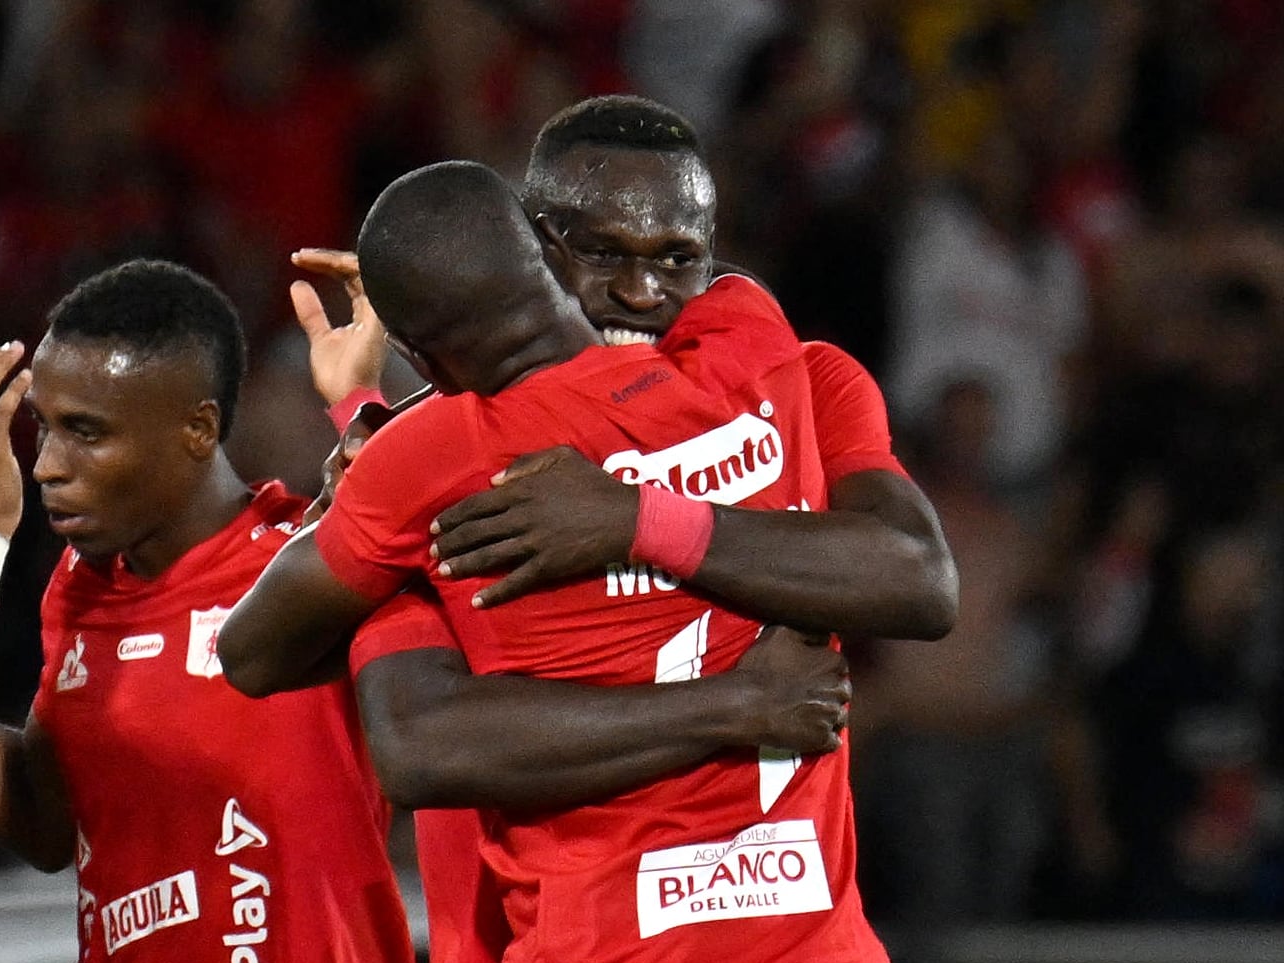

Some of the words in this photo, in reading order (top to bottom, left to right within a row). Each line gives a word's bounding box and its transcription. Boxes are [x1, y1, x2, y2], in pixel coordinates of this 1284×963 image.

[119, 641, 161, 655] Colanta
[658, 850, 806, 909] BLANCO
[690, 895, 728, 913] DEL
[735, 891, 780, 910] VALLE
